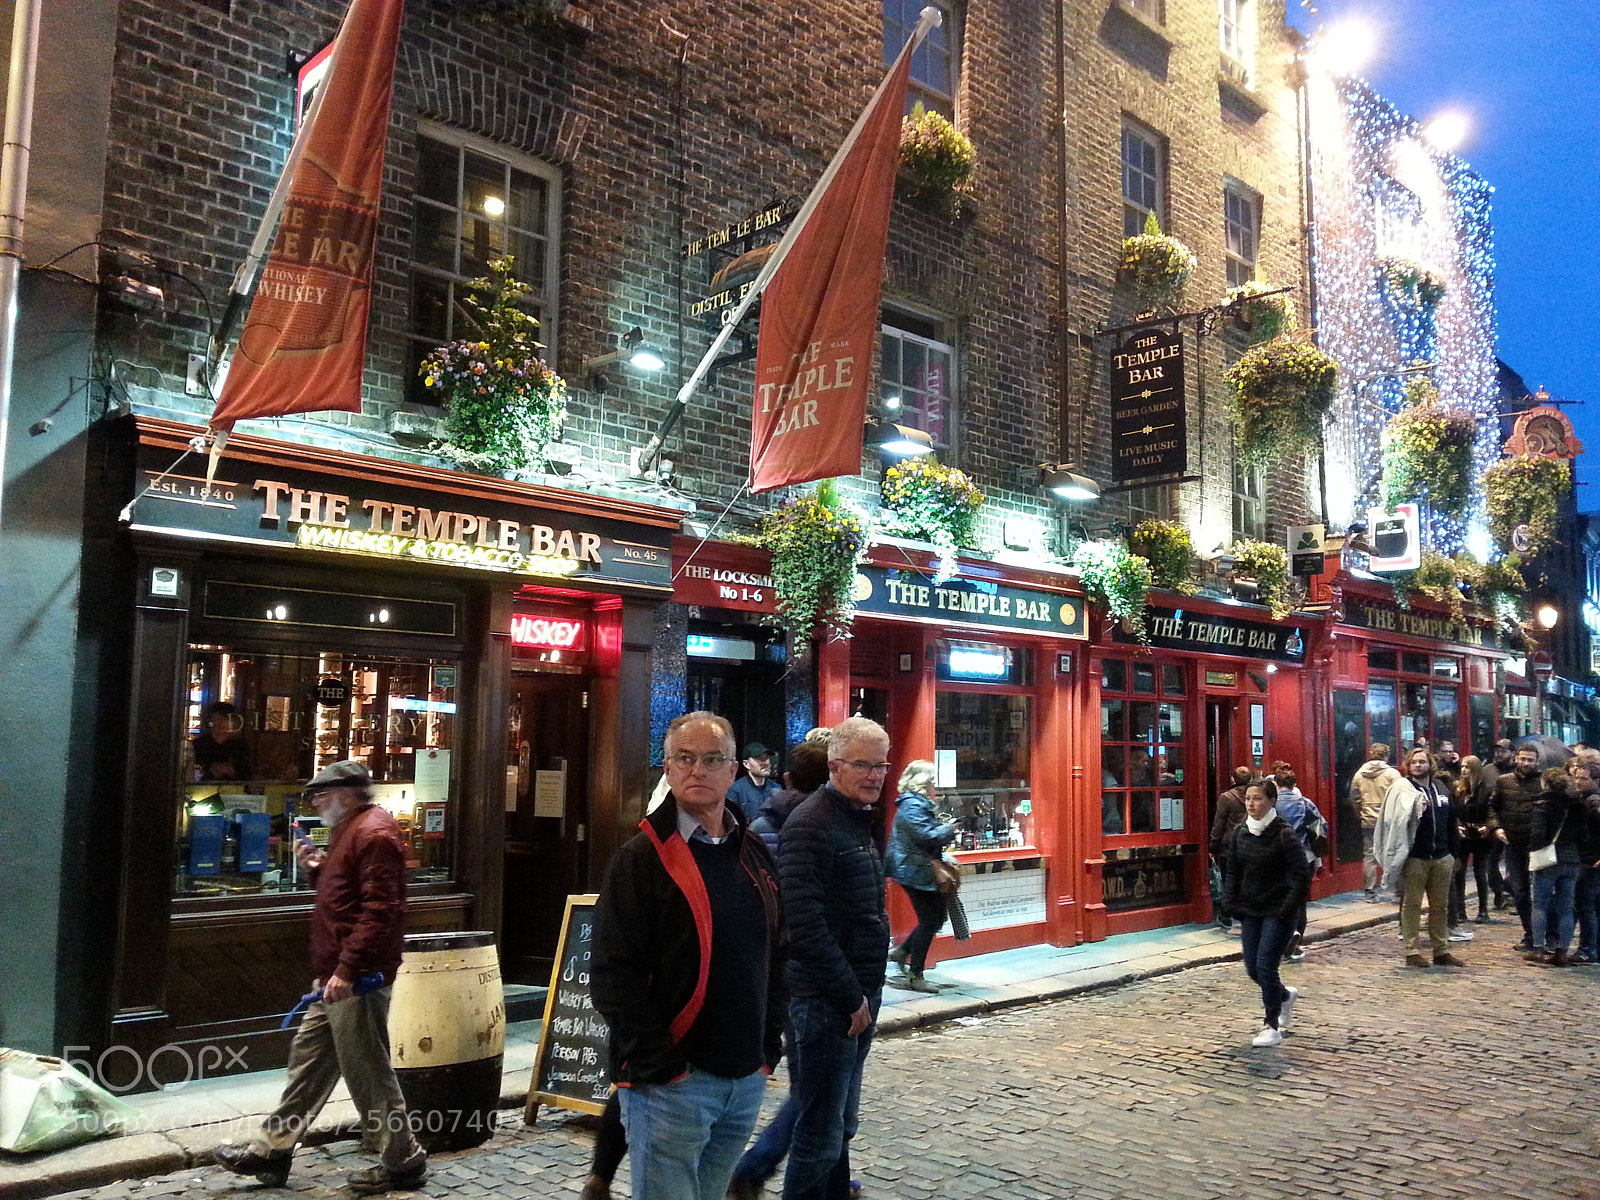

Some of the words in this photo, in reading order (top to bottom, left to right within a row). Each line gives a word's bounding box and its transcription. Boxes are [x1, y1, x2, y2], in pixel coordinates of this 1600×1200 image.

[1134, 335, 1158, 349] THE
[1114, 344, 1180, 370] TEMPLE
[1128, 366, 1165, 385] BAR
[773, 400, 820, 436] BAR
[1116, 407, 1140, 420] BEER
[1140, 400, 1179, 415] GARDEN
[1119, 445, 1143, 457] LIVE
[1143, 439, 1178, 452] MUSIC
[1132, 453, 1164, 467] DAILY
[149, 479, 183, 495] Est.
[189, 486, 235, 502] 1840
[252, 479, 350, 529] THE
[362, 499, 521, 552] TEMPLE
[530, 524, 602, 564] BAR
[297, 523, 408, 555] WHISKEY
[427, 540, 523, 569] TOBACCO
[624, 547, 642, 560] No.
[644, 549, 658, 562] 45
[685, 564, 712, 579] THE
[720, 585, 738, 600] No
[741, 588, 763, 602] 1-6
[885, 578, 930, 607] THE
[935, 587, 1011, 617] TEMPLE
[1015, 599, 1052, 622] BAR
[510, 616, 581, 647] HISKEY
[1152, 616, 1184, 639] THE
[1188, 621, 1246, 647] TEMPLE
[1247, 629, 1277, 651] BAR
[1364, 607, 1396, 630] THE
[1400, 614, 1455, 640] TEMPLE
[317, 686, 345, 699] THE
